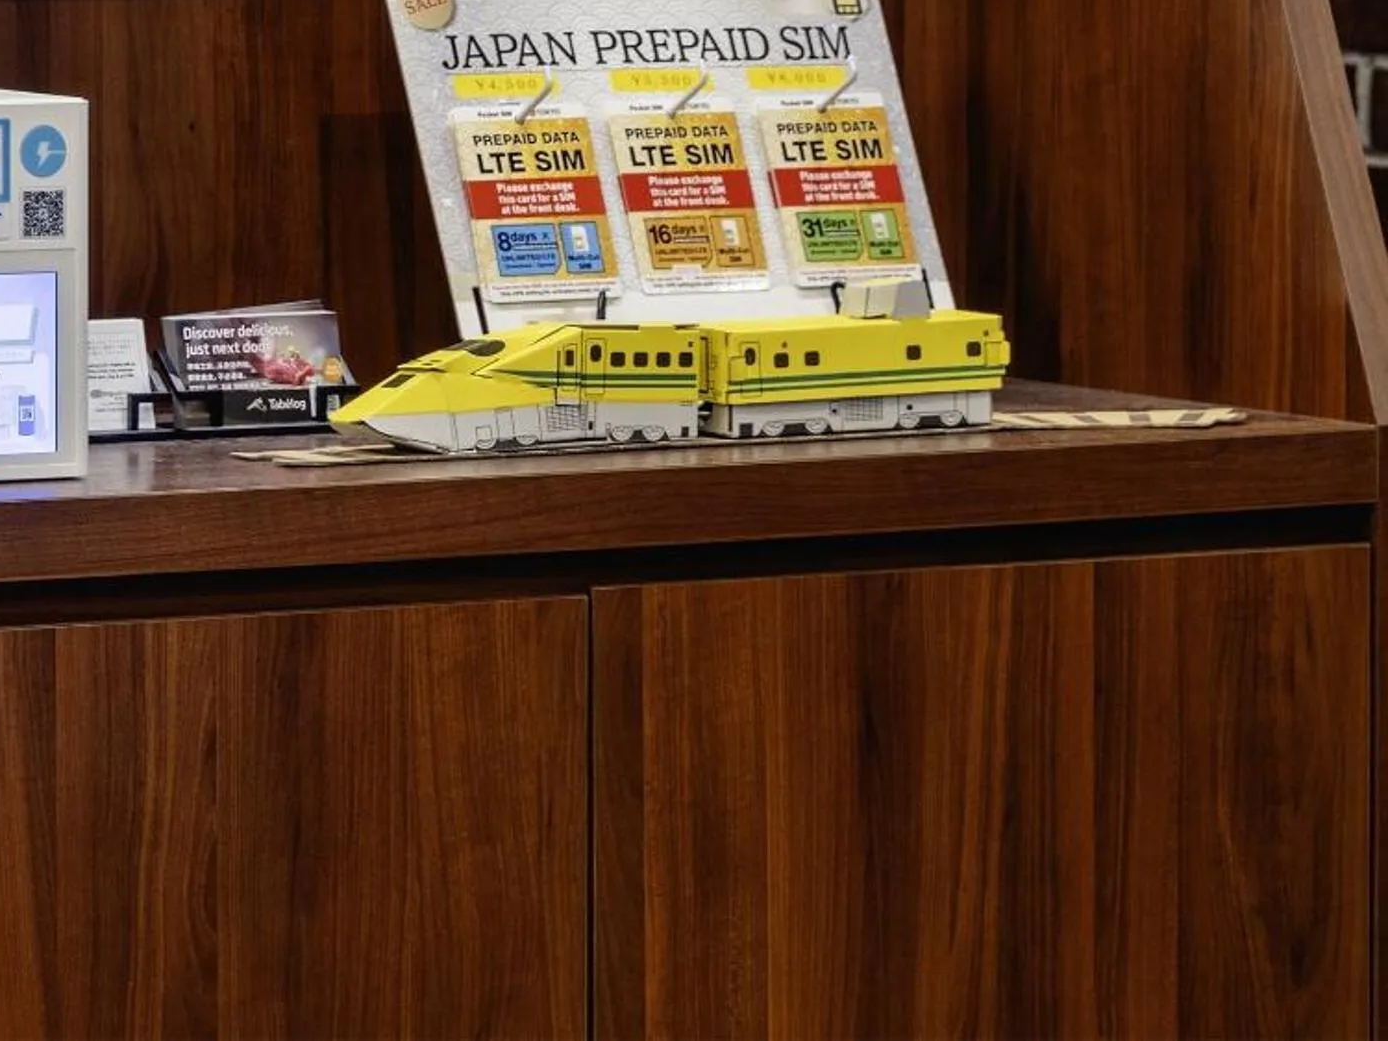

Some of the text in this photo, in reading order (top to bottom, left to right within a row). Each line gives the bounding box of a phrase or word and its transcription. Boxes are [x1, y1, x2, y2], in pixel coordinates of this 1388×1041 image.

[442, 25, 852, 70] JAPAN PREPAID SIM
[625, 125, 728, 140] PREPAID DATA
[776, 121, 878, 135] PREPAID DATA
[472, 131, 580, 147] PREPAID DATA
[628, 143, 734, 167] LTE SIM
[780, 139, 884, 162] LTE SIM
[477, 149, 586, 174] LTE SIM
[648, 175, 724, 187] Please exchange
[799, 170, 873, 182] Please exchange
[496, 182, 574, 194] Please exchange
[498, 195, 516, 205] this
[517, 195, 535, 204] card
[536, 194, 552, 204] for
[501, 204, 580, 215] at the front desk.
[648, 224, 698, 245] 16 days
[802, 218, 848, 238] 31 days
[497, 231, 538, 252] 8 days
[182, 325, 235, 341] Discover
[185, 343, 210, 359] just
[212, 343, 240, 356] next
[268, 396, 307, 411] Tabelog
